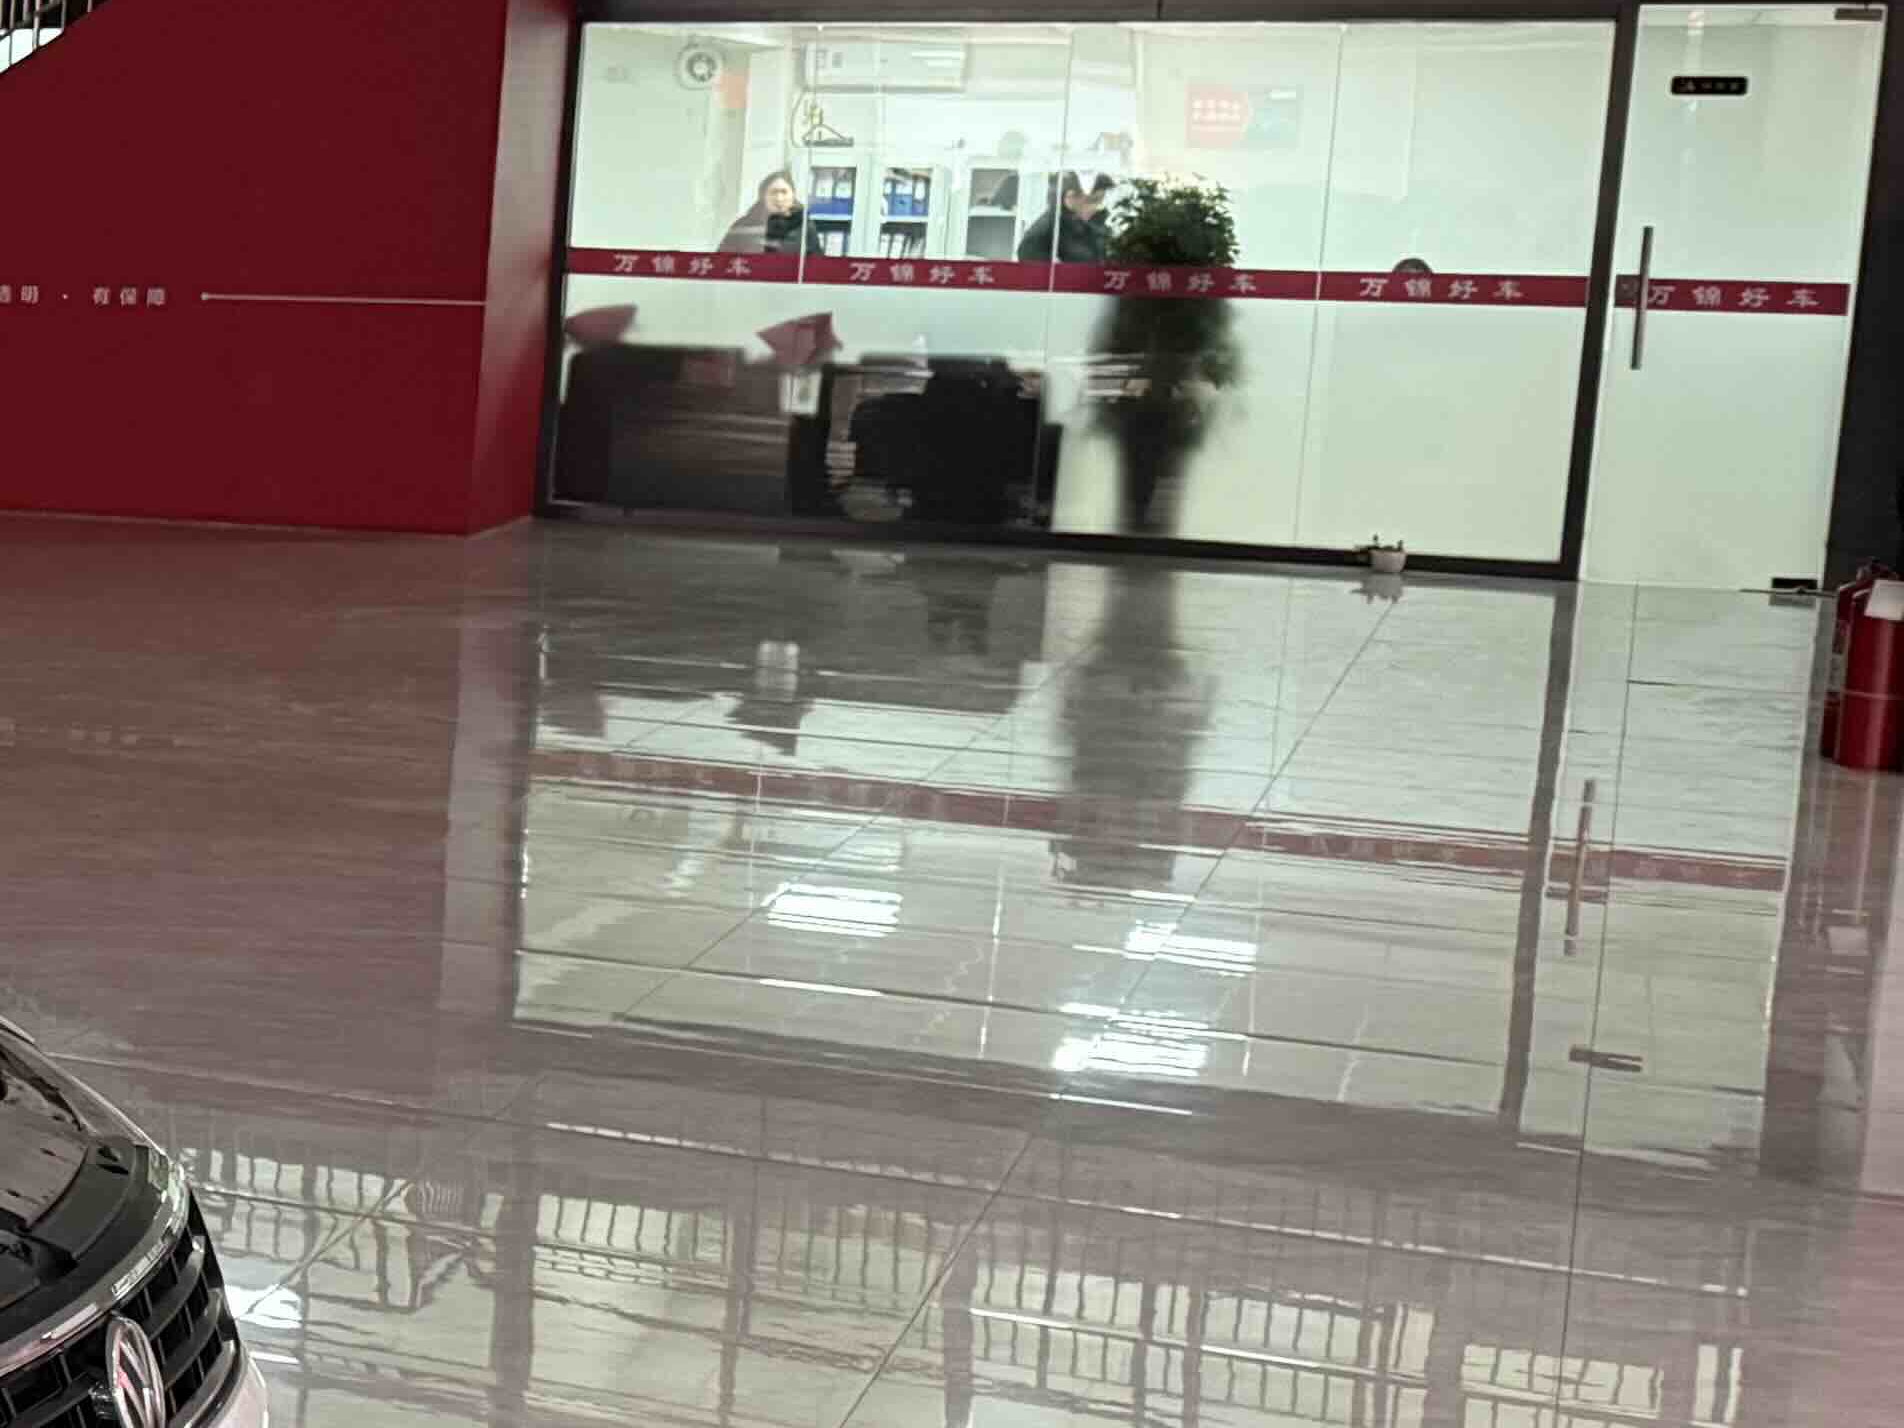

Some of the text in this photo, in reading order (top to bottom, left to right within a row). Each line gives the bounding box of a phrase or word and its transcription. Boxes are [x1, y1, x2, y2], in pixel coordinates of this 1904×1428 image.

[613, 253, 753, 276] 万锦好车
[848, 262, 996, 285] 万锦好车
[1103, 270, 1257, 293] 万锦好车
[1359, 277, 1523, 299] 万锦好车
[1648, 285, 1820, 308] 万锦好车
